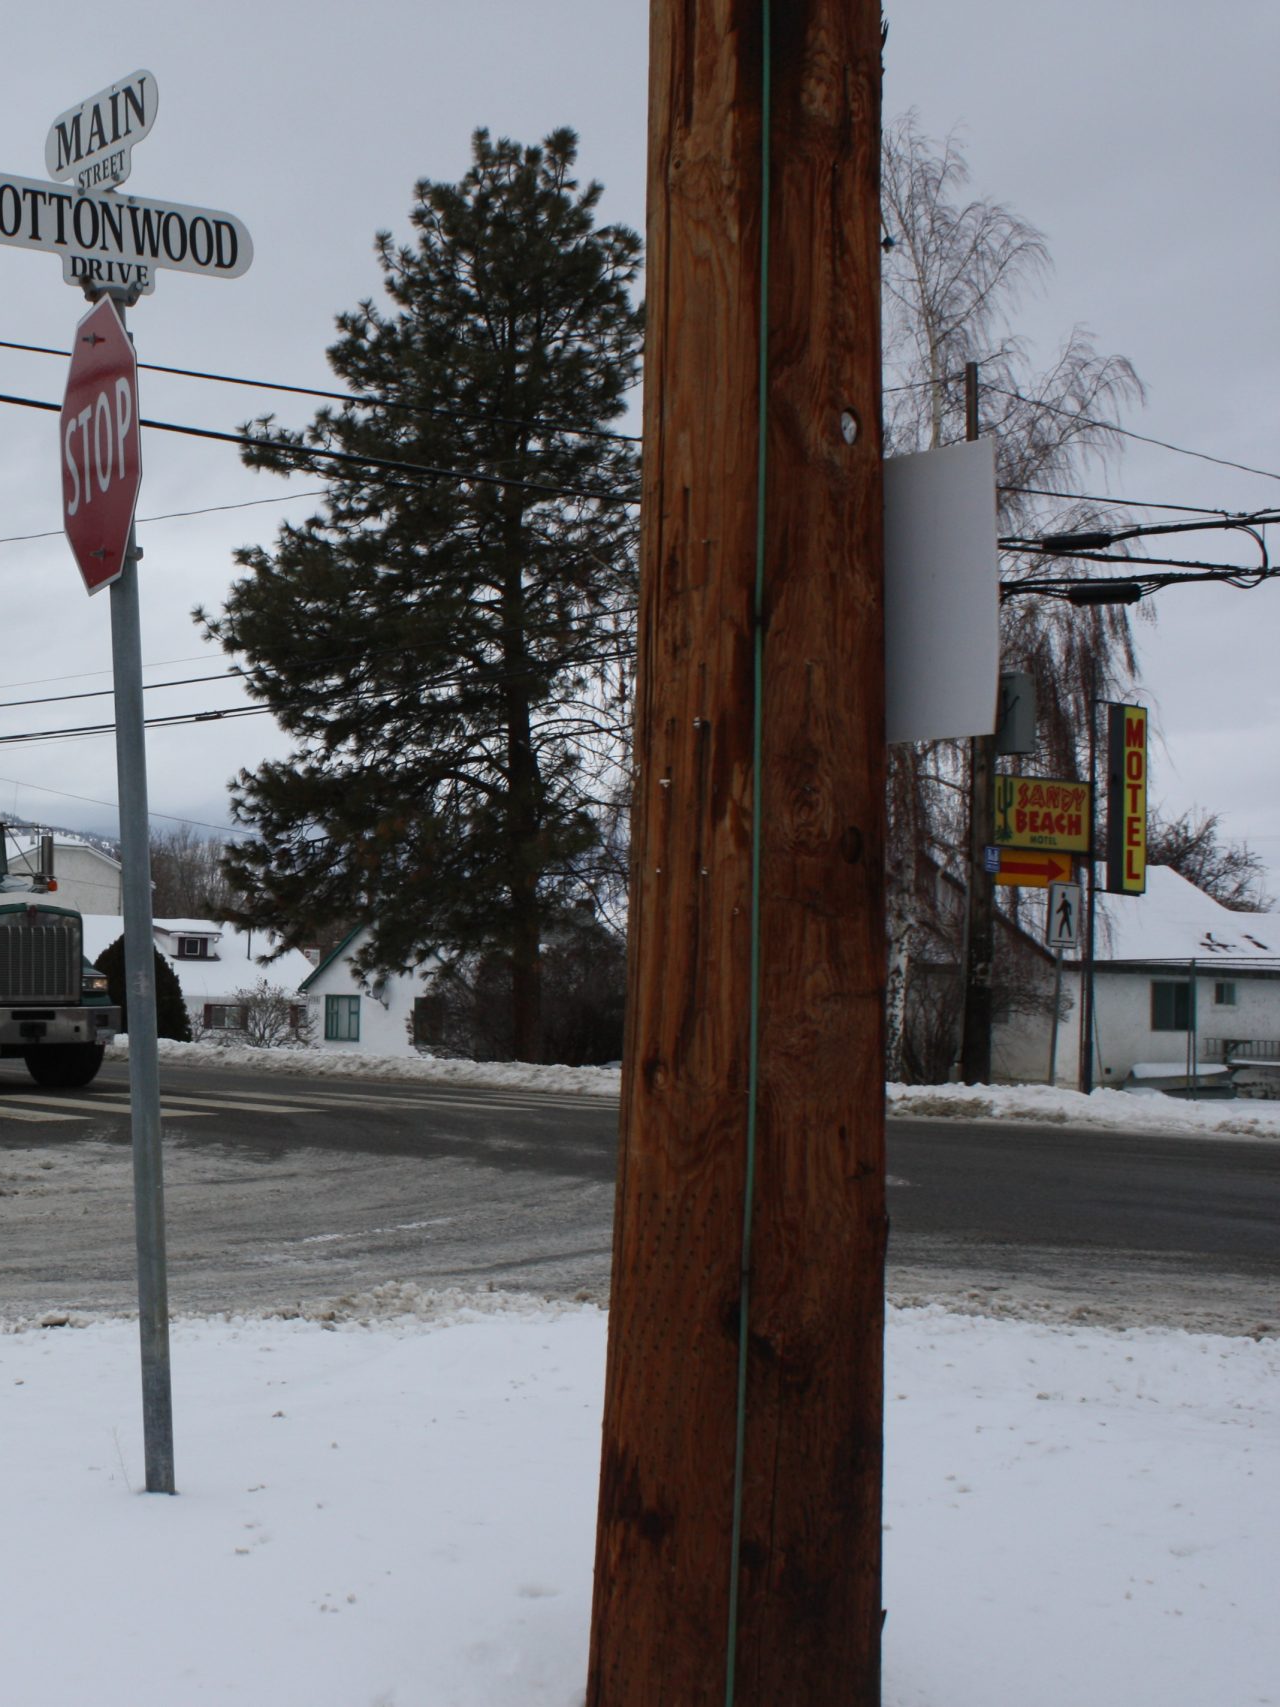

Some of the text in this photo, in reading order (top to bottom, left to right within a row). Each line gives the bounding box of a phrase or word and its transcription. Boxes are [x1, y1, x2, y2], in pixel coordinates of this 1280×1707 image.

[55, 77, 146, 172] MAIN
[78, 150, 126, 190] STREET
[70, 256, 149, 287] DRIVE
[65, 376, 132, 516] STOP
[1017, 782, 1086, 812] SANDY
[1126, 718, 1144, 880] MOTEL
[1015, 808, 1082, 836] BEACH
[1030, 835, 1057, 846] MOTEL
